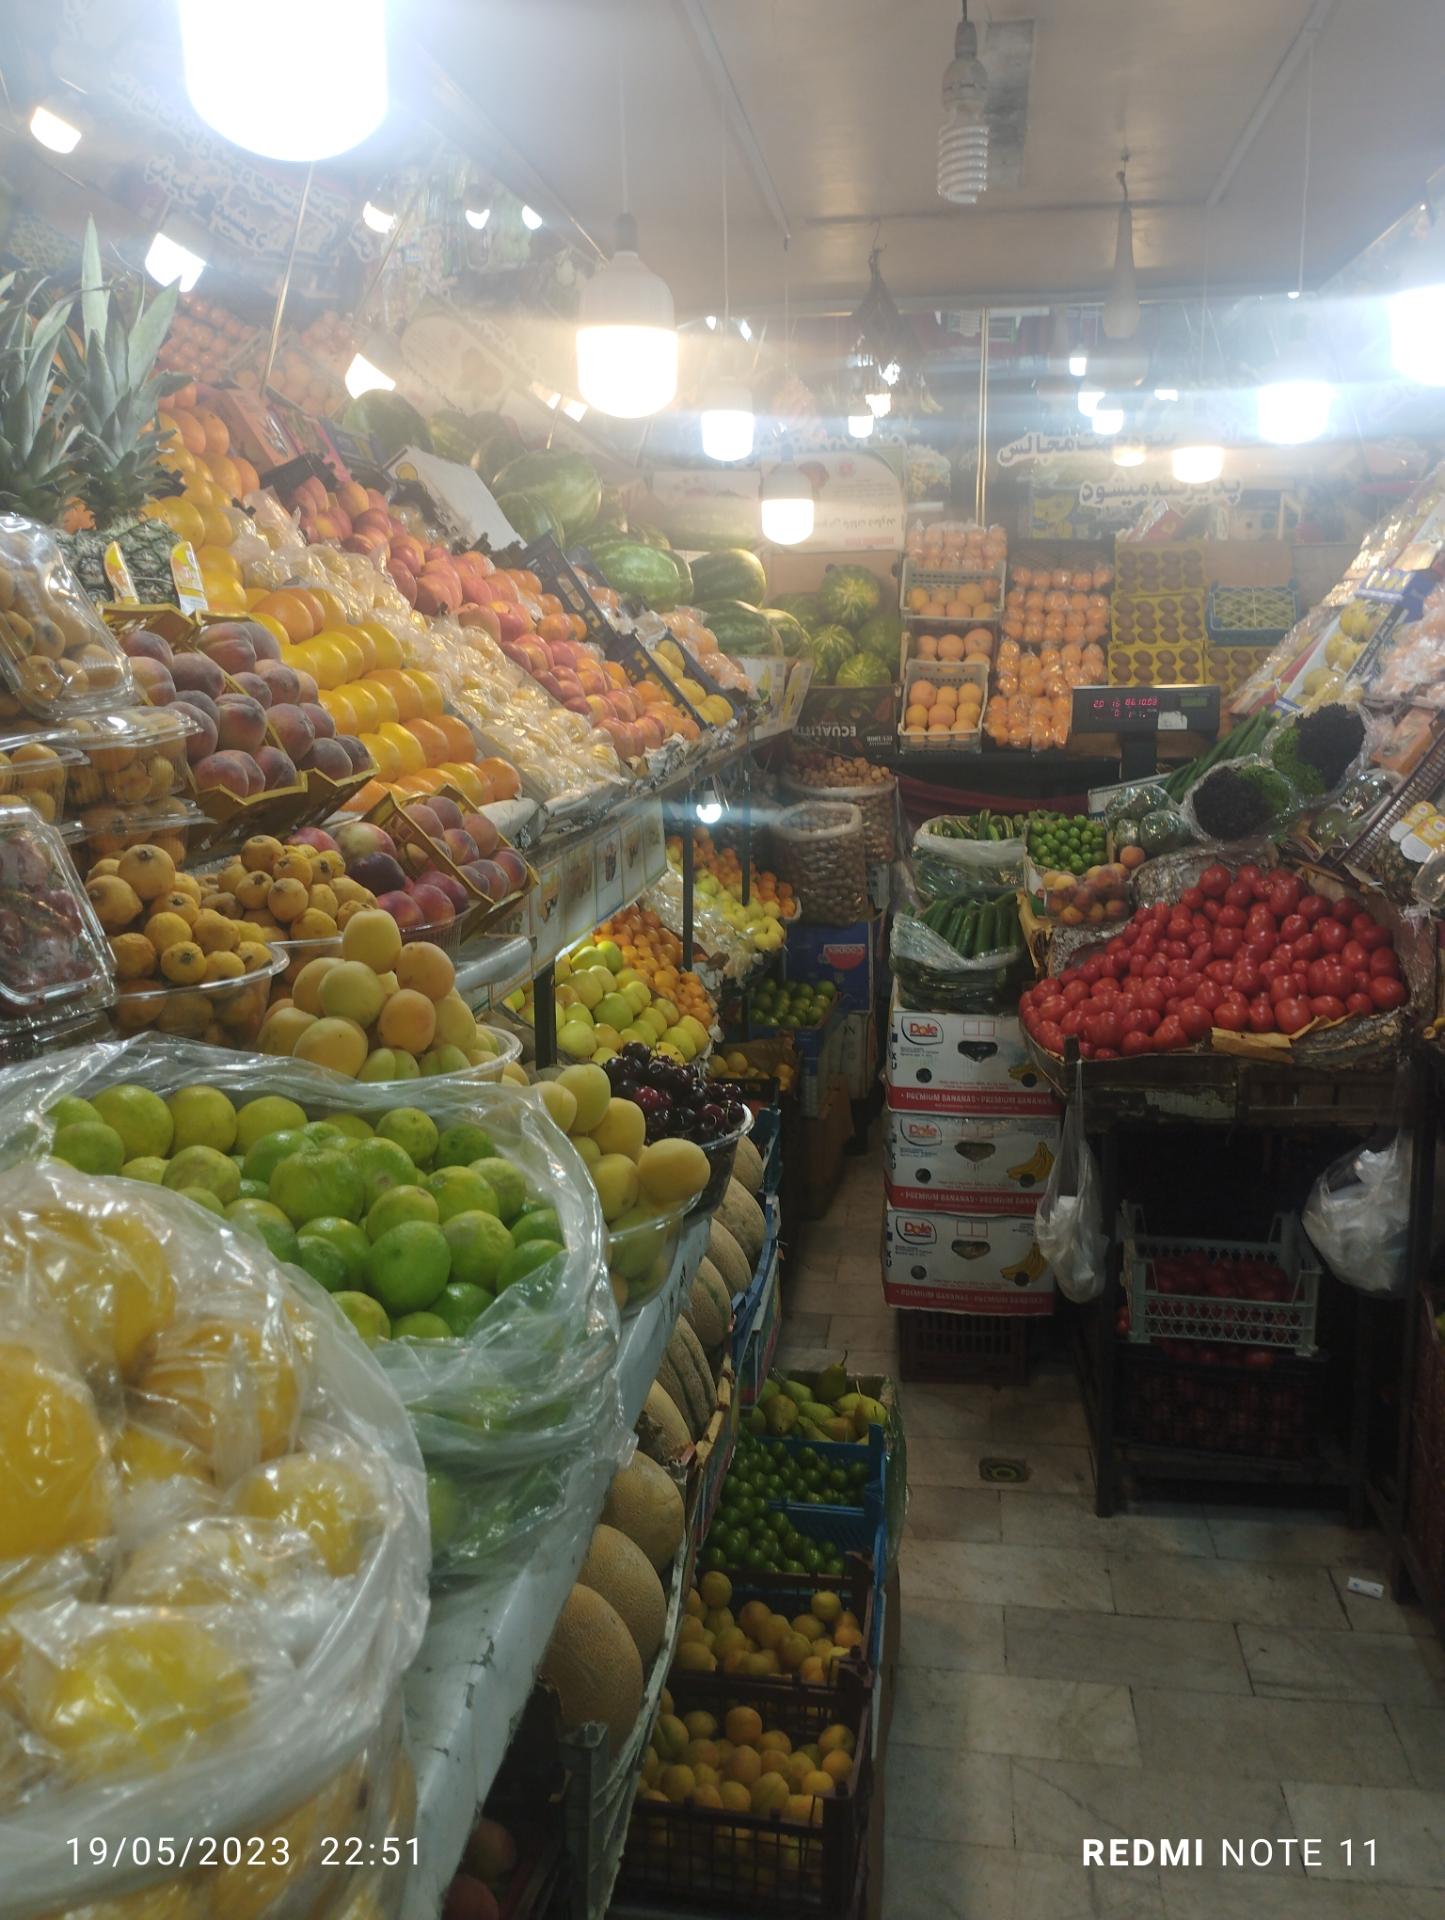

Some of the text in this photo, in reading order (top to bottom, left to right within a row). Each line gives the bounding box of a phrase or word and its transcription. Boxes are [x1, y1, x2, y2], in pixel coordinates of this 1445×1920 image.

[1082, 476, 1152, 506] میشود
[909, 1022, 938, 1034] Dole
[906, 1091, 941, 1101] PREMIUM
[941, 1093, 976, 1103] BANANAS
[980, 1095, 1016, 1104] PREMIUM
[908, 1123, 938, 1136] Dole
[905, 1191, 939, 1201] PREMIUM
[940, 1193, 975, 1202] BANANAS
[979, 1195, 1014, 1204] PREMIUM
[904, 1221, 933, 1234] Dole
[900, 1288, 935, 1299] PREMIUM
[935, 1291, 970, 1301] BANANAS
[973, 1294, 1009, 1304] PREMIUM
